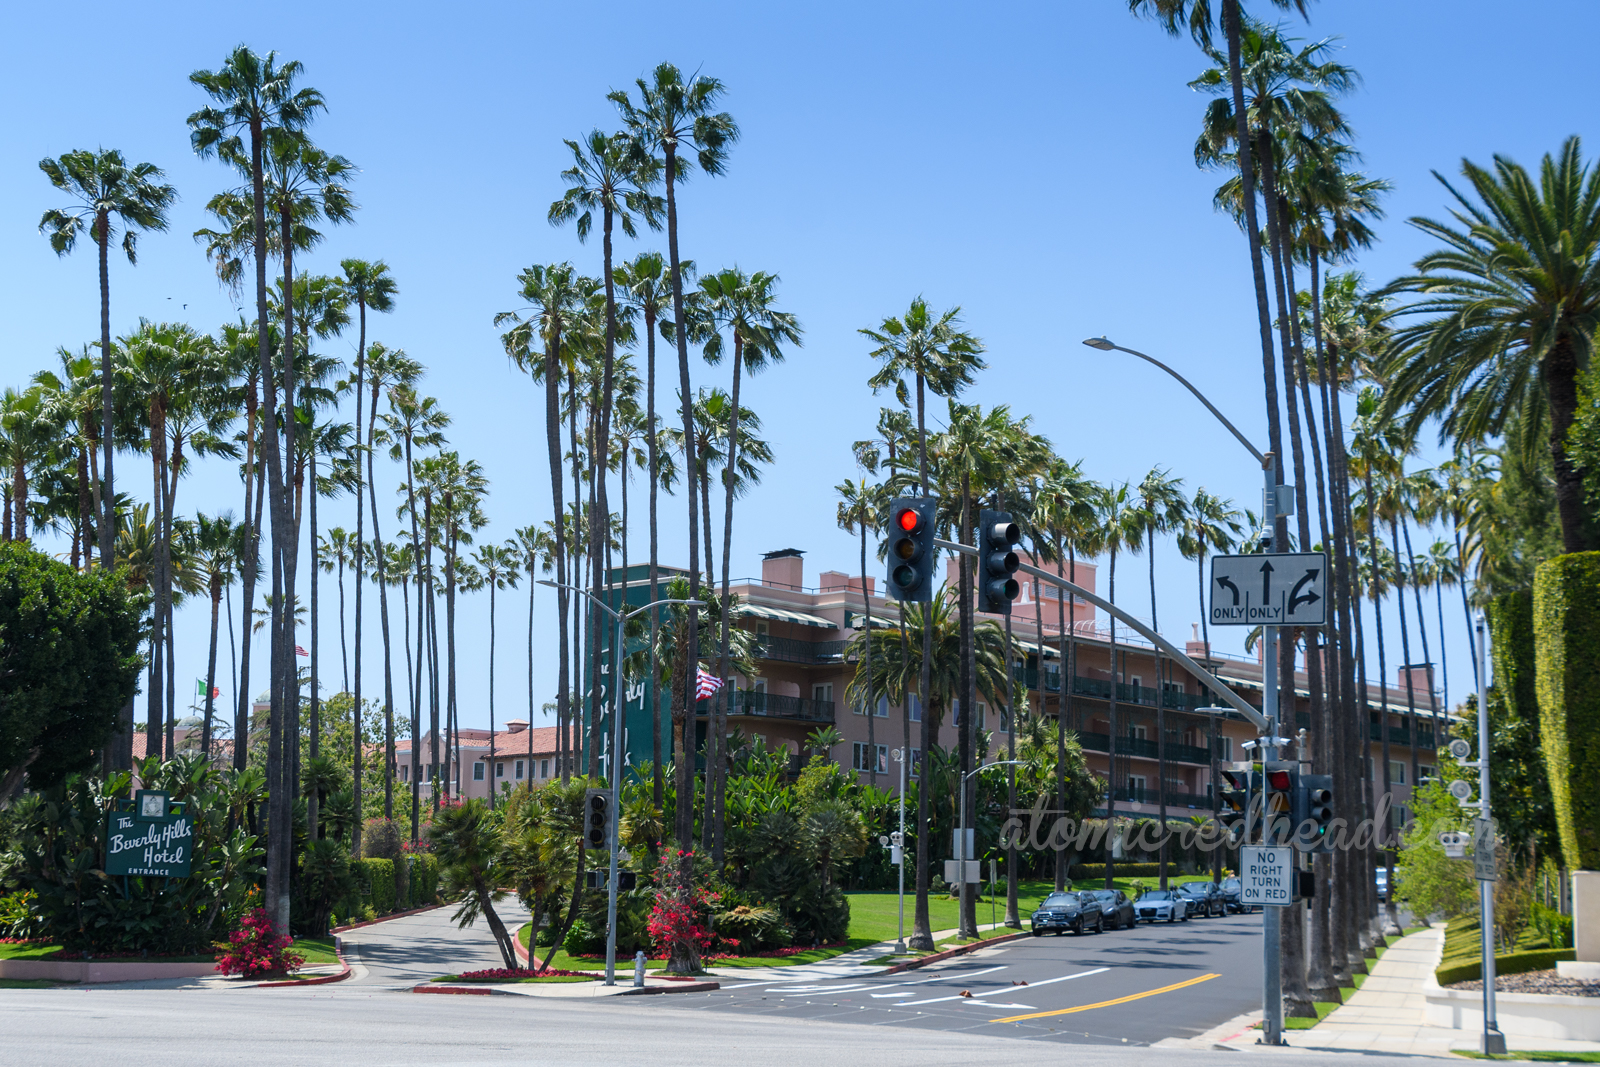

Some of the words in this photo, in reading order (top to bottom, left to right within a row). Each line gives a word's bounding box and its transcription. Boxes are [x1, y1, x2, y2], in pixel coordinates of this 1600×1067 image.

[1213, 607, 1245, 619] ONLY
[1249, 607, 1281, 618] ONLY
[117, 816, 134, 829] The
[109, 823, 161, 854] Beverly
[162, 818, 192, 848] Hills
[143, 846, 184, 868] Hotel
[1257, 852, 1276, 863] NO
[1250, 865, 1283, 875] RIGHT
[1251, 877, 1281, 887] TURN
[1245, 888, 1260, 898] ON
[1265, 889, 1287, 899] RED
